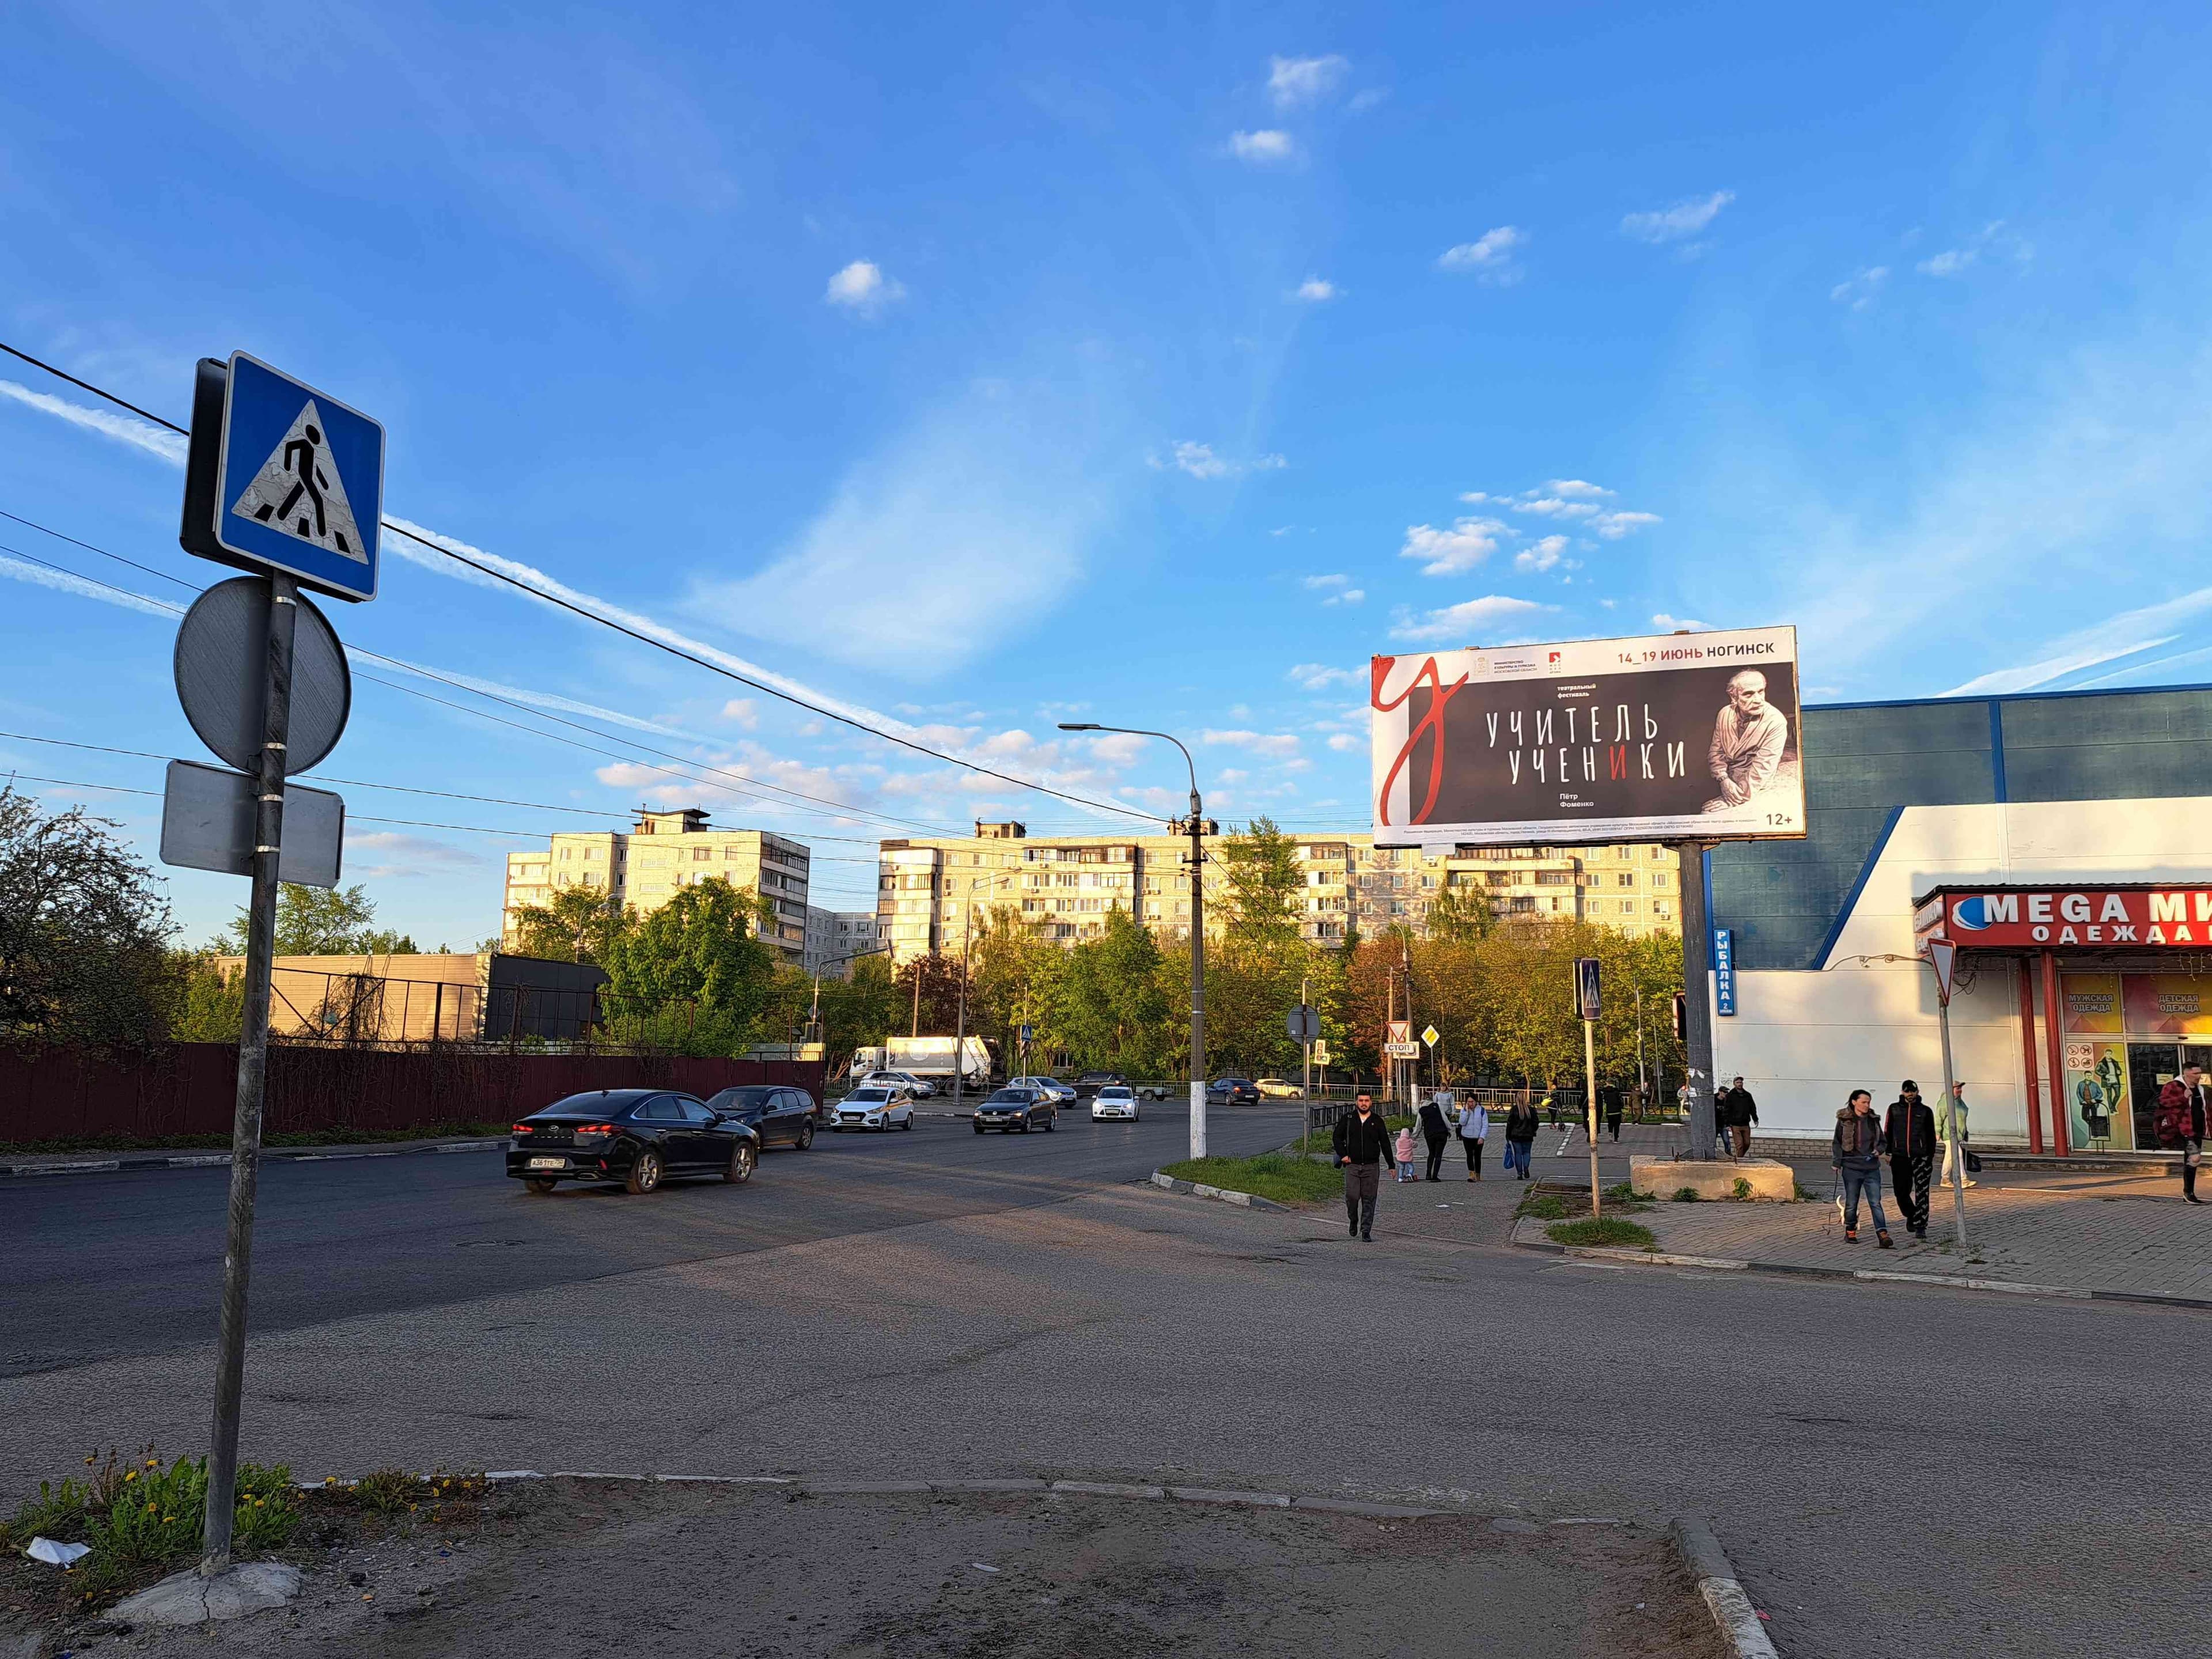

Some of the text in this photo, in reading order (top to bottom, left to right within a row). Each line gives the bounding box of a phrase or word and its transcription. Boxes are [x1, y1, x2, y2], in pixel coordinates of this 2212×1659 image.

[1660, 648, 1703, 661] ИЮНЬ
[1707, 642, 1775, 657] НОГИНСК
[1557, 683, 1596, 691] театральный
[1486, 703, 1658, 748] УЧИТЕЛЬ
[1509, 741, 1685, 785] УЧЕНИКИ
[1560, 793, 1578, 801] Пётр
[1766, 813, 1793, 825] 12+
[1983, 893, 2130, 923] MEGA
[2032, 925, 2194, 944] ОДЕЖДА
[1717, 931, 1730, 1000] РЫБАЛКА
[2069, 994, 2113, 1003] МУЖСКАЯ
[2158, 994, 2199, 1003] ДЕТСКАЯ
[2073, 1003, 2111, 1013] ОДЕЖДА
[2160, 1003, 2199, 1013] ОДЕЖДА
